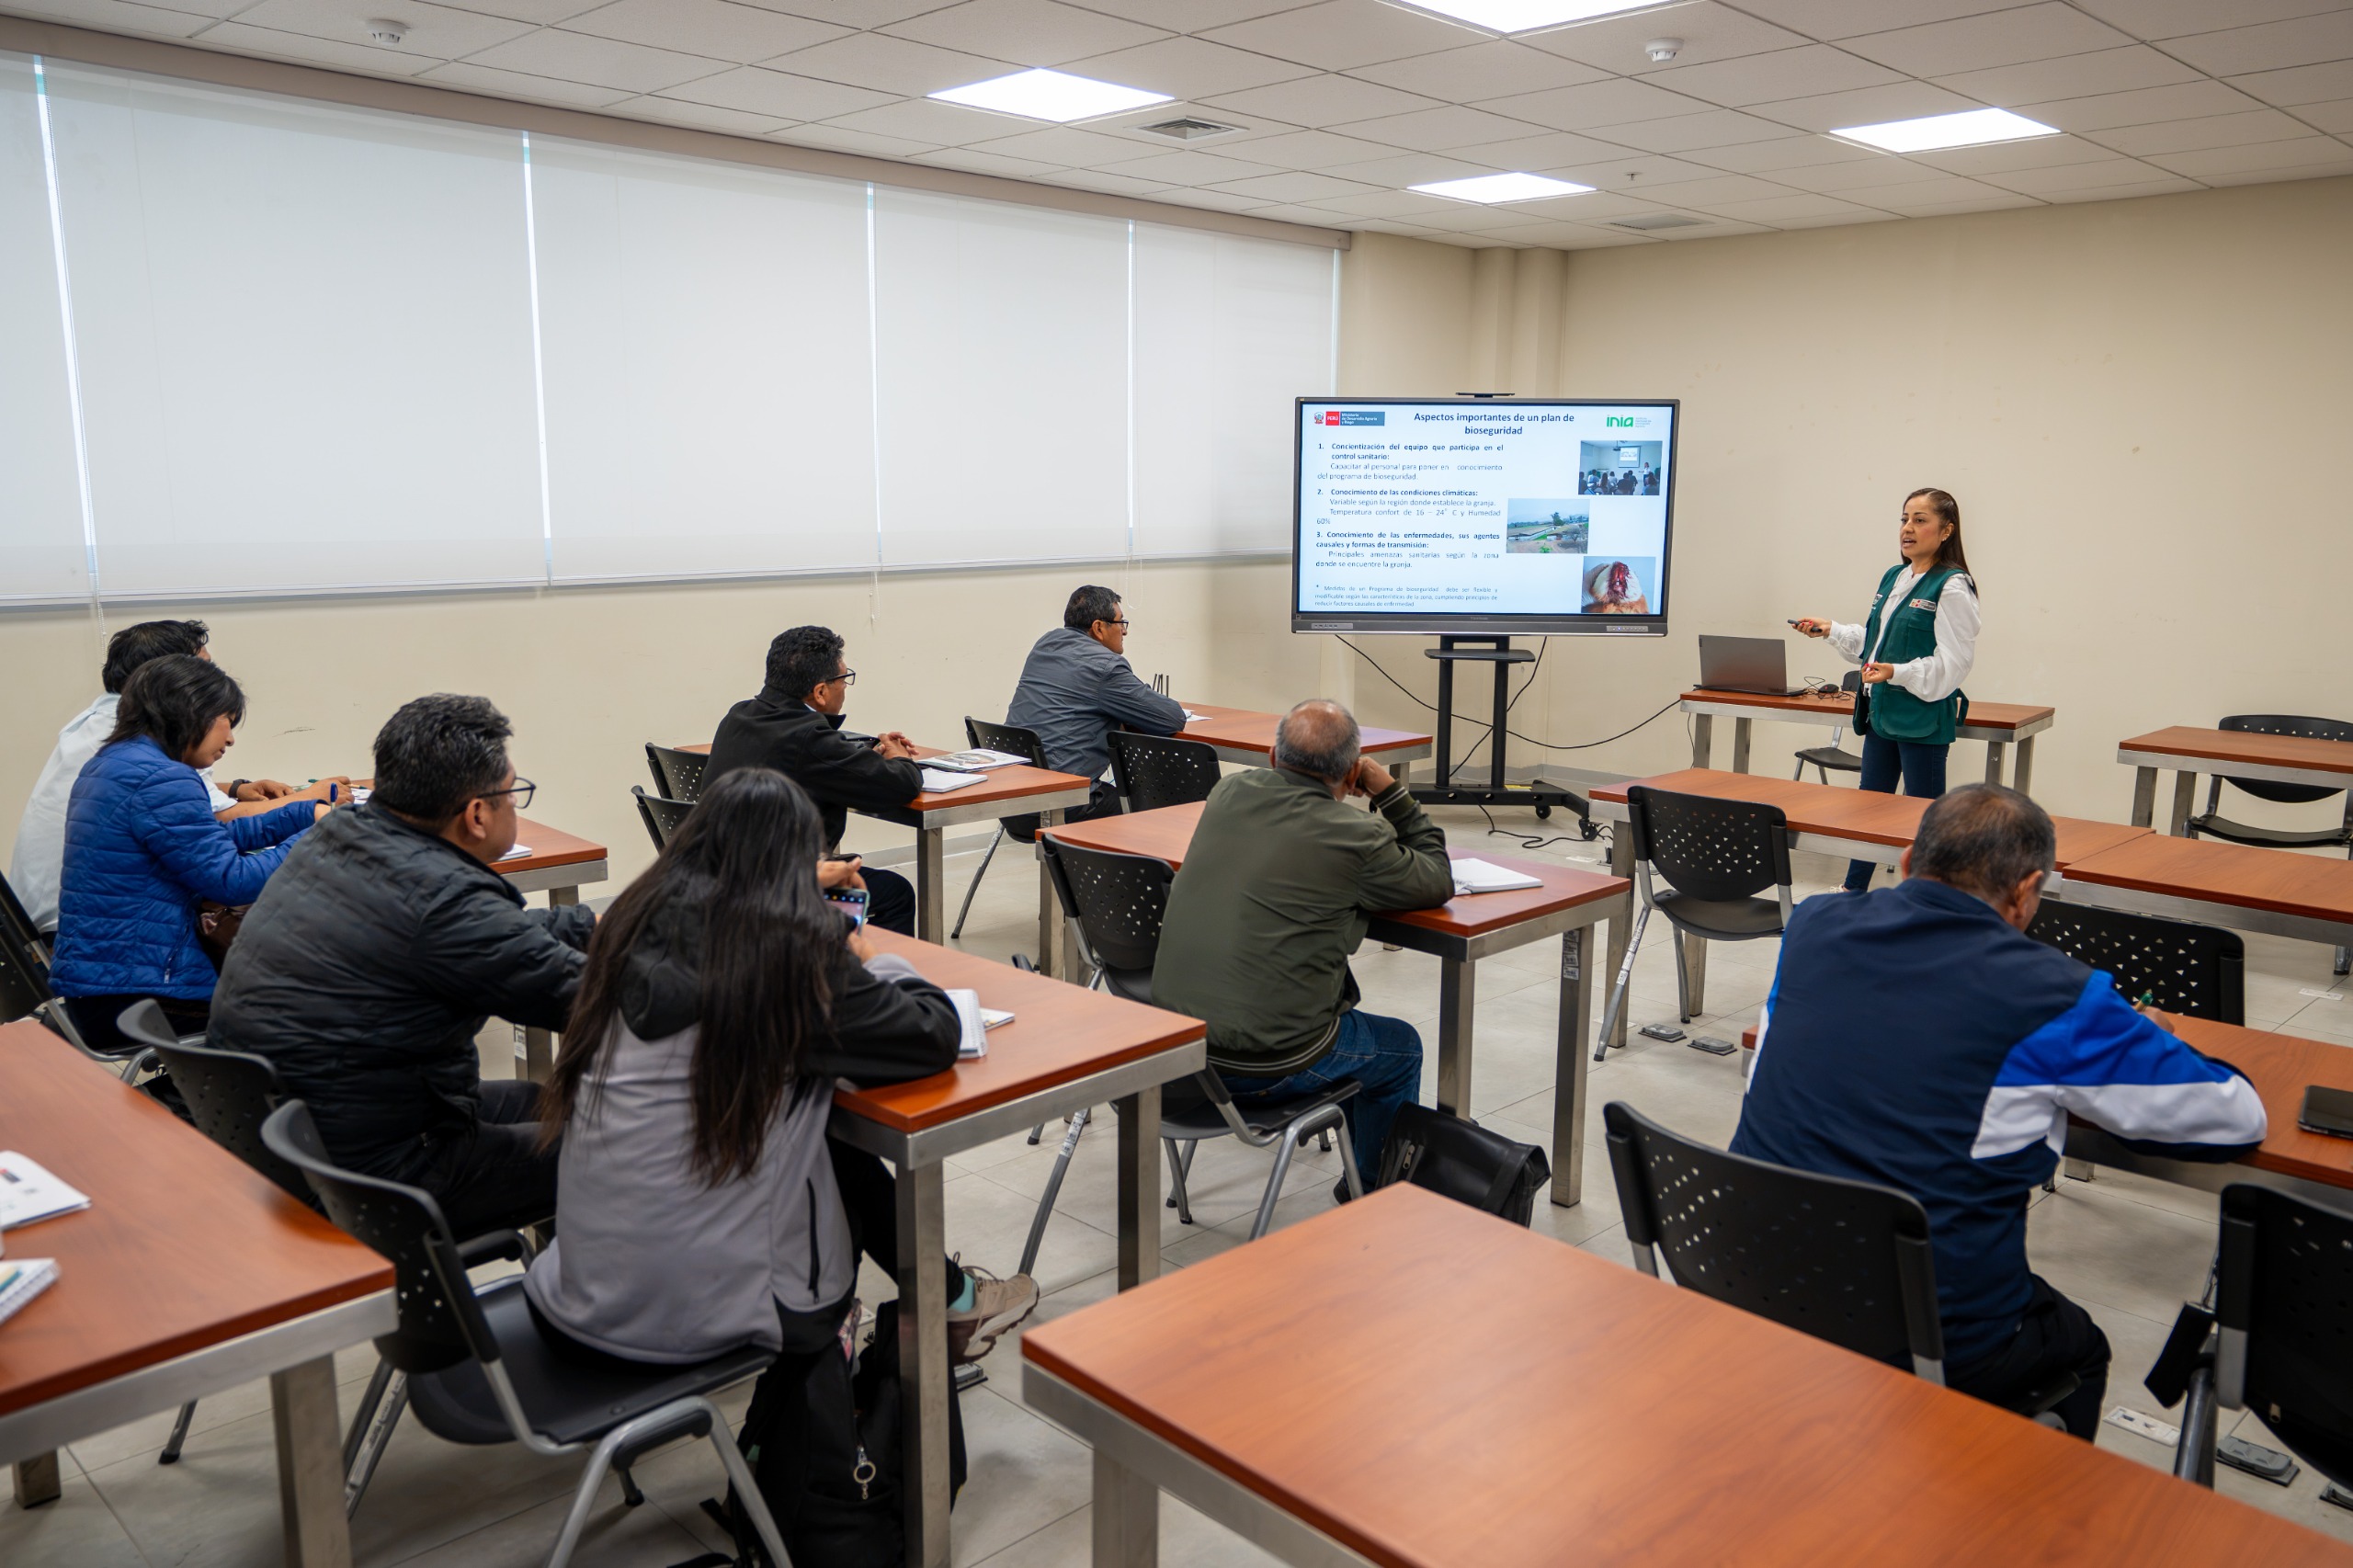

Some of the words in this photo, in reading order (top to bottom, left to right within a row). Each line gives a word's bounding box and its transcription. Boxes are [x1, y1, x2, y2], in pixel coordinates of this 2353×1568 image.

[1414, 413, 1454, 423] Aspectos
[1456, 413, 1511, 423] importantes
[1541, 413, 1561, 423] plan
[1464, 426, 1522, 436] bioseguridad
[1330, 463, 1361, 471] Capacitar
[1371, 463, 1400, 471] personal
